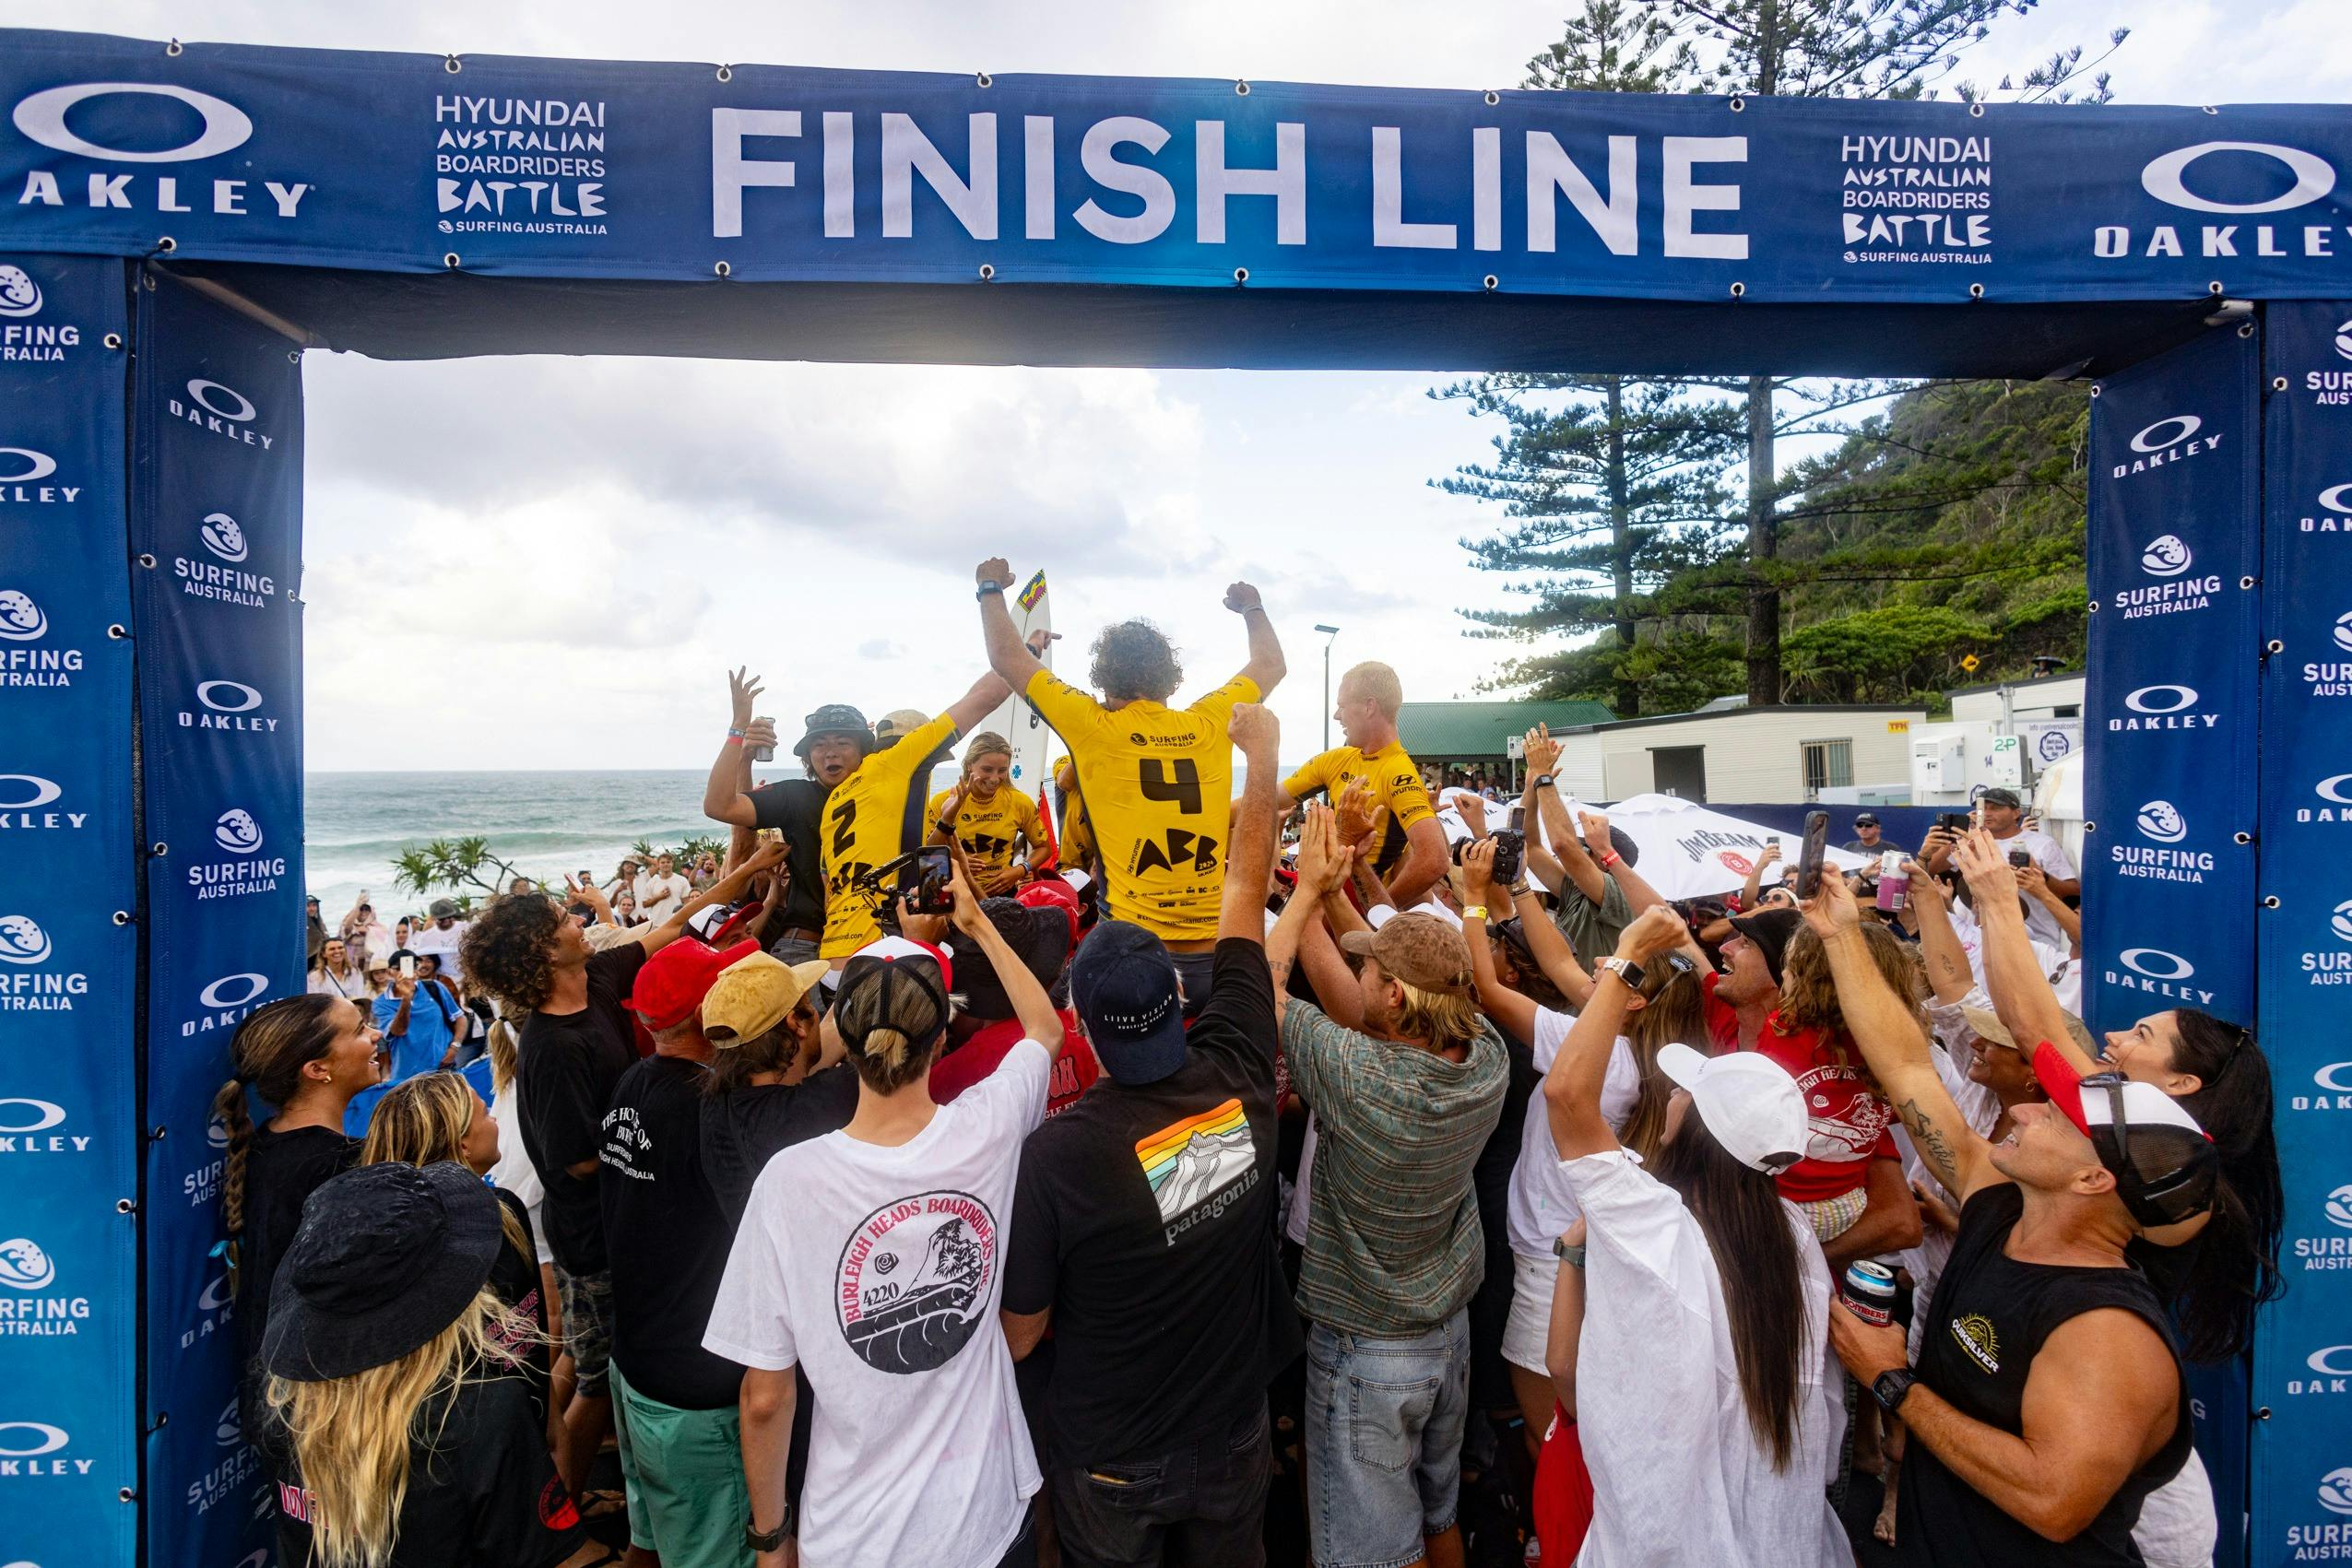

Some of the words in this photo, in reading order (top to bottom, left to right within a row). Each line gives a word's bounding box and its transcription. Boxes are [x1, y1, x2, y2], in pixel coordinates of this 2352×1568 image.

[437, 96, 605, 127] HYUNDAI
[437, 129, 605, 152] AUSTRALIAN
[1842, 136, 1990, 162] HYUNDAI
[437, 155, 605, 177] BOARDRIDERS
[1843, 167, 1991, 187] AUSTRALIAN
[713, 108, 1306, 244] FINISH
[1372, 126, 1748, 259] LINE
[438, 178, 608, 217] BATTLE
[1843, 191, 1991, 208] BOARDRIDERS
[455, 221, 523, 233] SURFING
[526, 223, 608, 235] AUSTRALIA
[1843, 213, 1992, 246] BATTLE
[2094, 227, 2352, 257] OAKLE
[1860, 253, 1919, 263] SURFING
[1921, 253, 1992, 264] AUSTRALIA
[0, 325, 79, 346] FING
[170, 399, 272, 450] OAKLEY
[2113, 433, 2220, 478] OAKLEY
[174, 558, 275, 596] SURFING
[184, 582, 265, 608] AUSTRALIA
[2115, 575, 2221, 608] SURFING
[2123, 595, 2209, 619] AUSTRALIA
[179, 712, 278, 732] OAKLEY
[2109, 714, 2217, 732] OAKLEY
[1150, 733, 1196, 743] SURFING
[1140, 759, 1202, 815] 4
[832, 798, 857, 858] 2
[2112, 845, 2214, 871] SURFING
[188, 856, 285, 887] SURFING
[2119, 864, 2203, 884] AUSTRALIA
[197, 877, 276, 900] AUSTRALIA
[2105, 970, 2215, 1006] OAKLEY
[1104, 1014, 1135, 1022] LIIVE
[1141, 994, 1173, 1020] VISION
[637, 1128, 652, 1150] OF
[1164, 1168, 1259, 1246] patagonia
[843, 1236, 874, 1324] BURLEIGH
[867, 1200, 921, 1239] HEADS
[928, 1198, 994, 1261] BOARDRIDERS
[863, 1282, 900, 1306] 4220
[1952, 1318, 2000, 1373] QUIKSILVER
